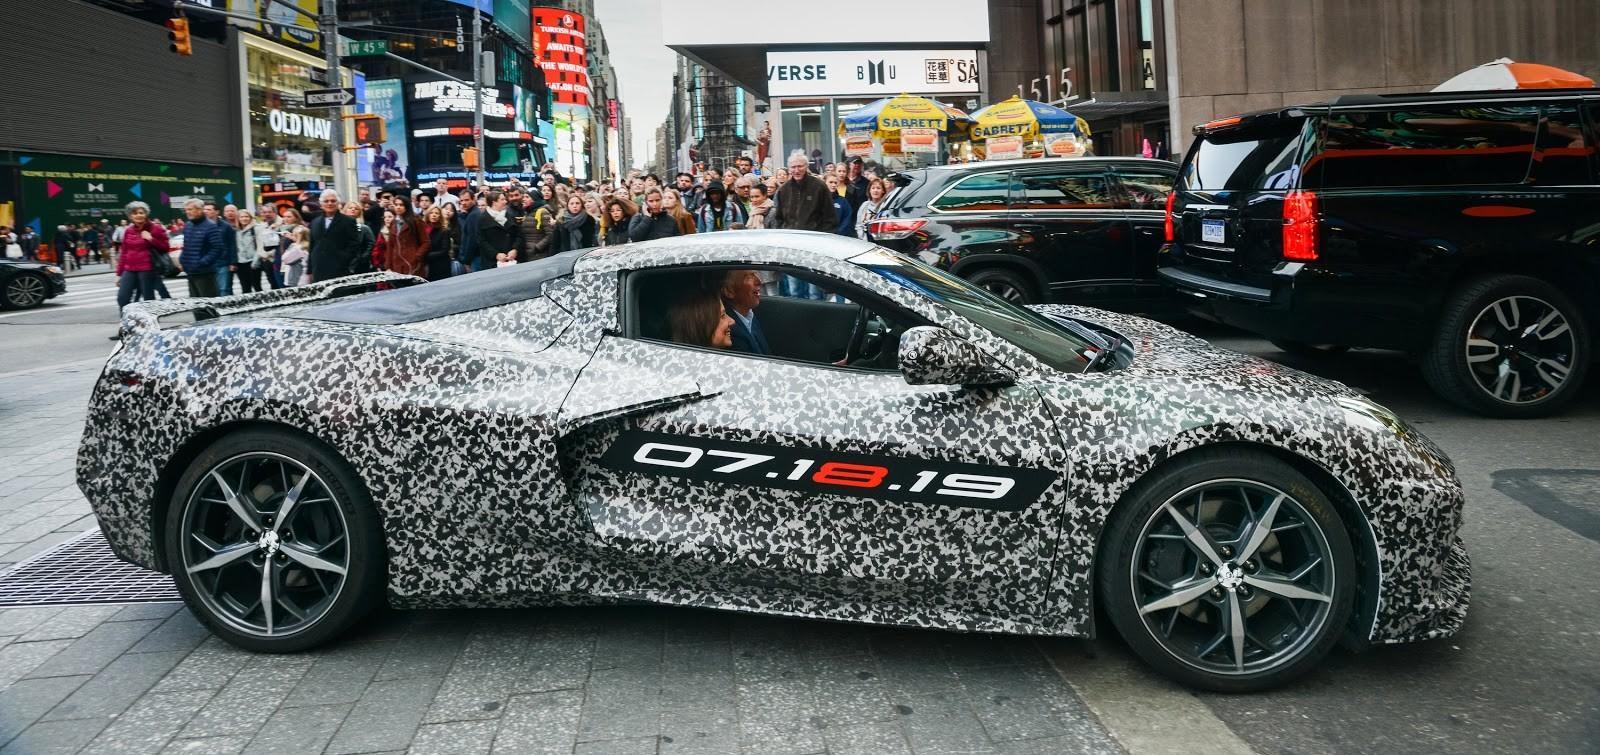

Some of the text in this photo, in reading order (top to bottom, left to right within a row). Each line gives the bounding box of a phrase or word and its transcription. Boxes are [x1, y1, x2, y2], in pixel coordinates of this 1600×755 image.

[456, 15, 465, 52] 1500
[351, 44, 359, 54] W
[363, 43, 375, 54] 45
[547, 43, 574, 52] AWAITS
[541, 61, 557, 70] THE
[857, 65, 864, 80] B
[888, 65, 897, 79] U
[1017, 67, 1072, 102] 1515
[312, 94, 326, 103] ONE
[270, 109, 331, 141] OLD NAV
[883, 118, 942, 128] SABRETT
[974, 124, 1031, 137] SABRETT
[633, 442, 1015, 500] 07.18.19
